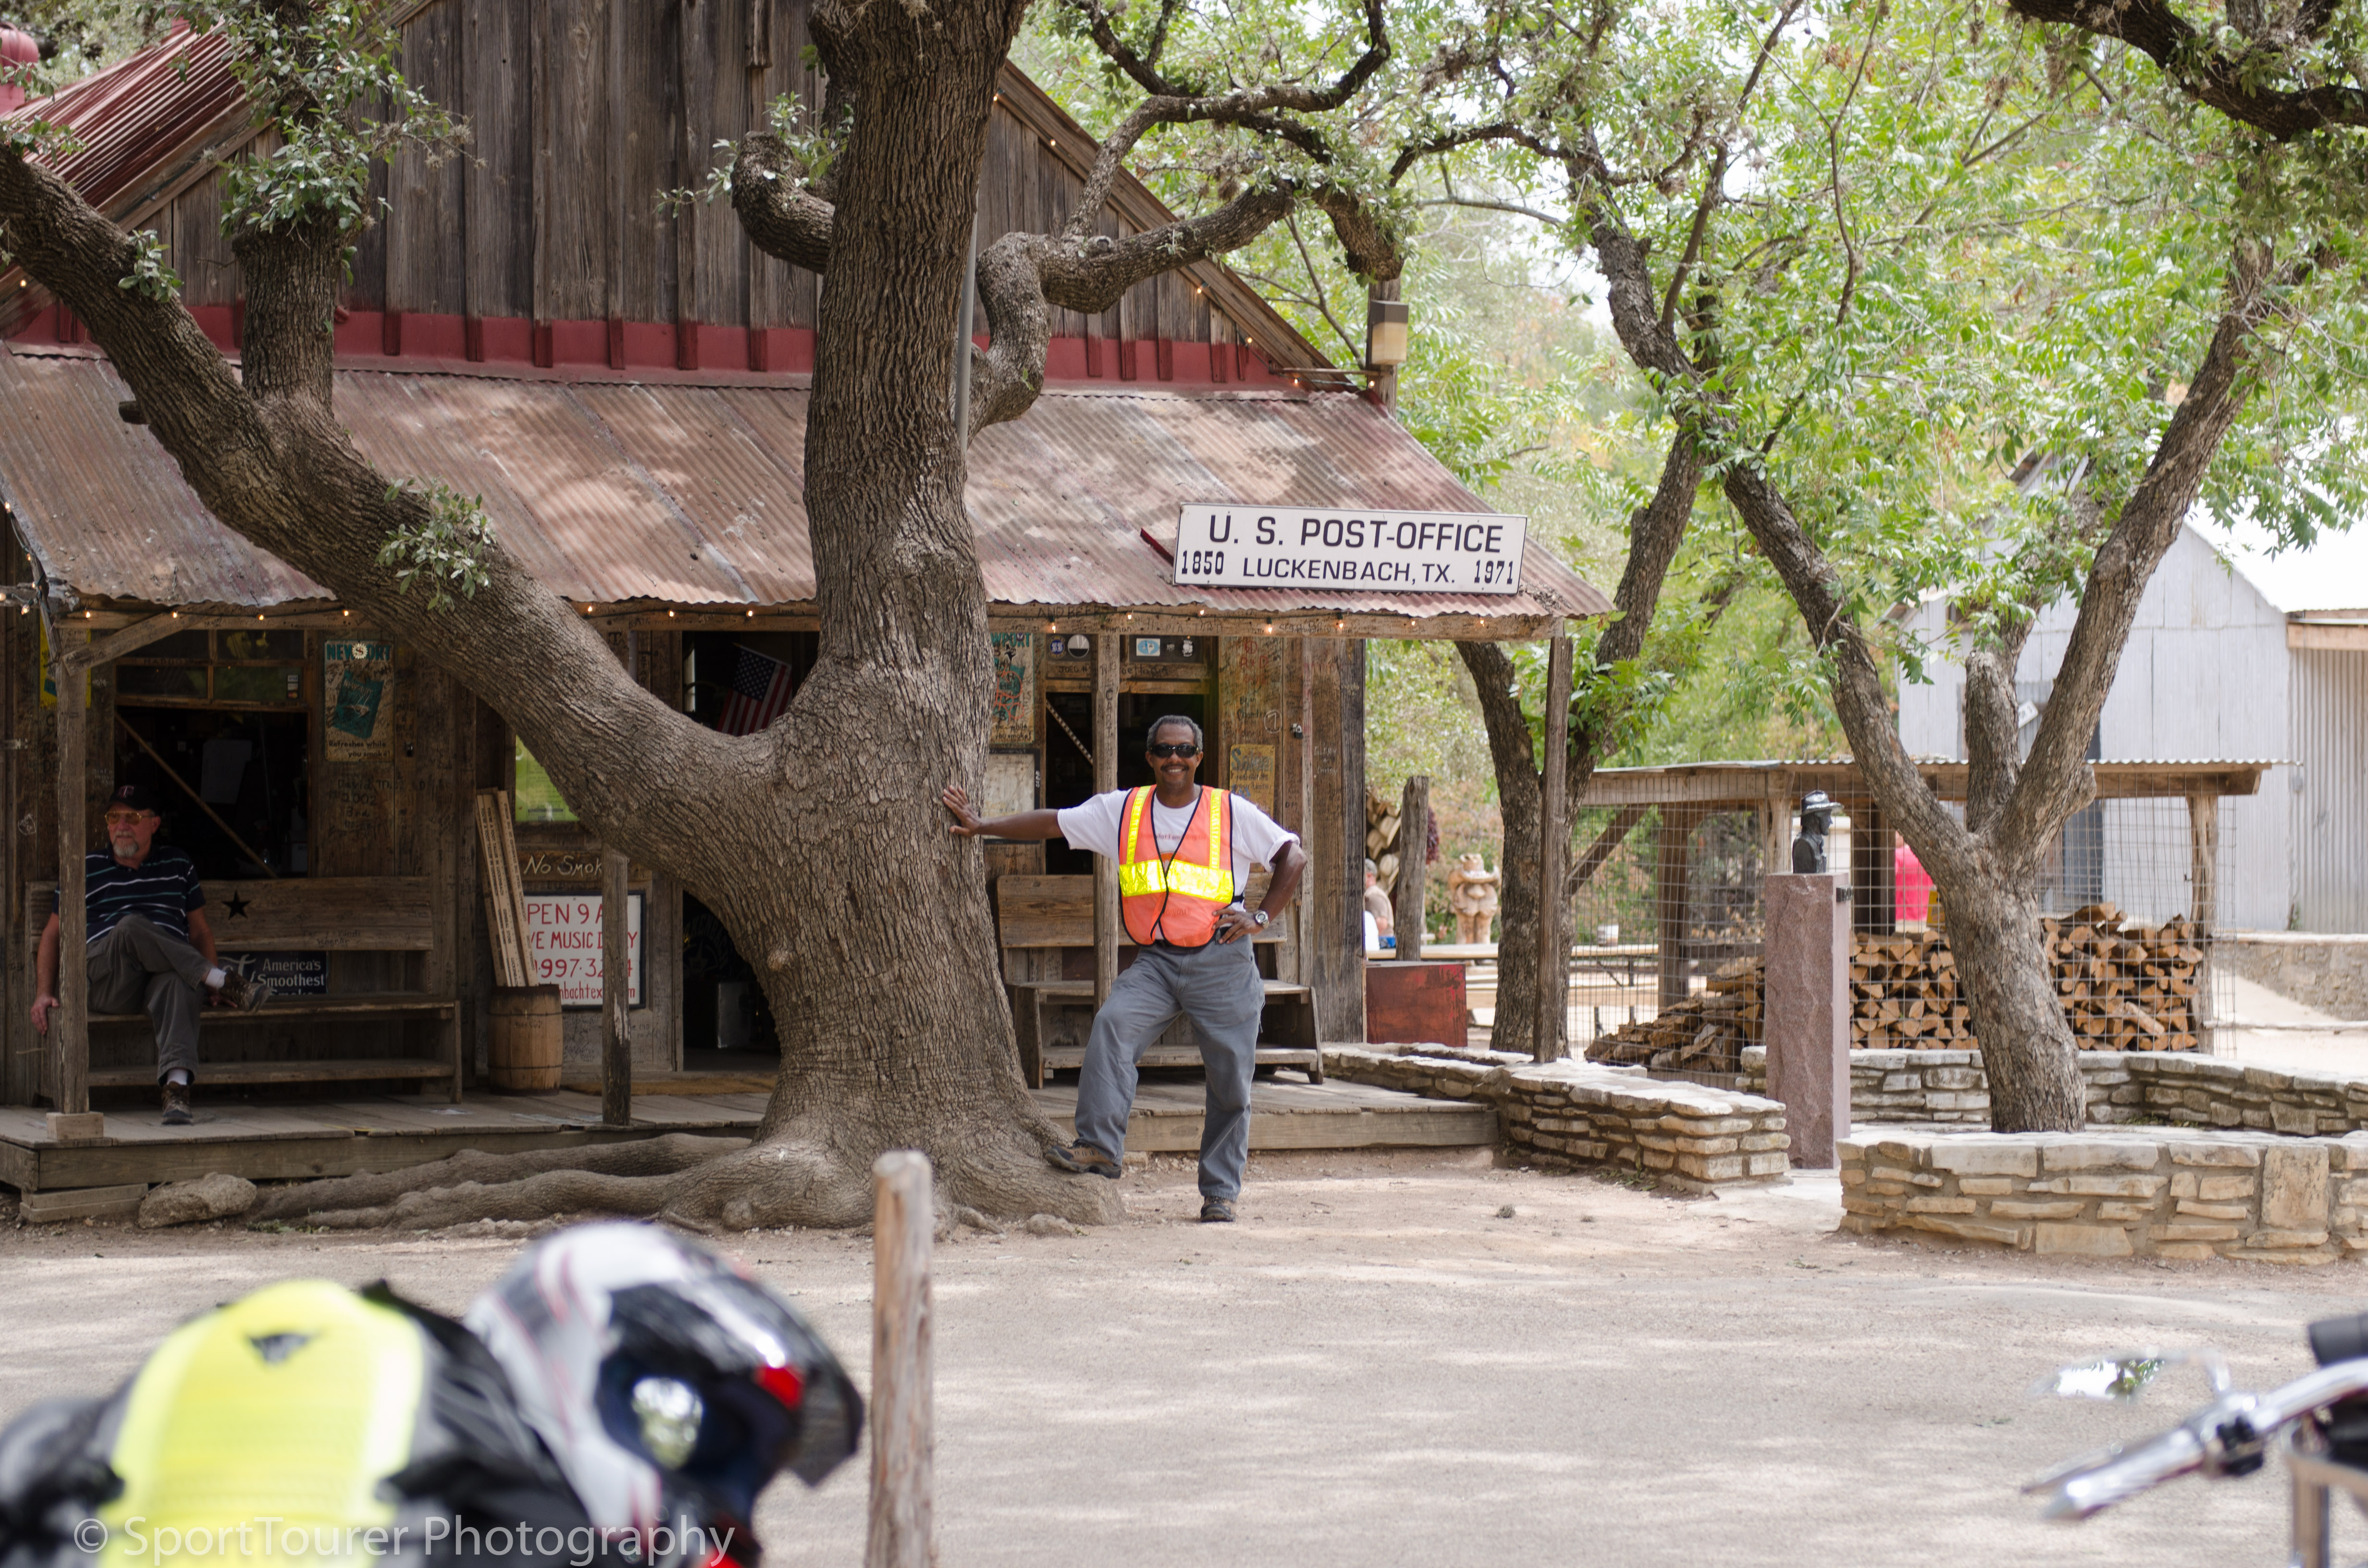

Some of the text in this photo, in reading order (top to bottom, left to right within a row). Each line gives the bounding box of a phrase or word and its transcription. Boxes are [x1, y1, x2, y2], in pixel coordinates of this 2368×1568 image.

[1209, 515, 1503, 552] U. S. POST-OFFICE
[1182, 550, 1514, 585] 1850 LUCKENBACH, TX. 1971
[327, 644, 391, 660] NEWORT
[523, 854, 603, 877] No Smok
[527, 903, 569, 924] PEN
[578, 903, 590, 924] 9
[551, 931, 593, 949] MUSIC
[262, 958, 321, 972] America's
[257, 972, 325, 987] Smoothest
